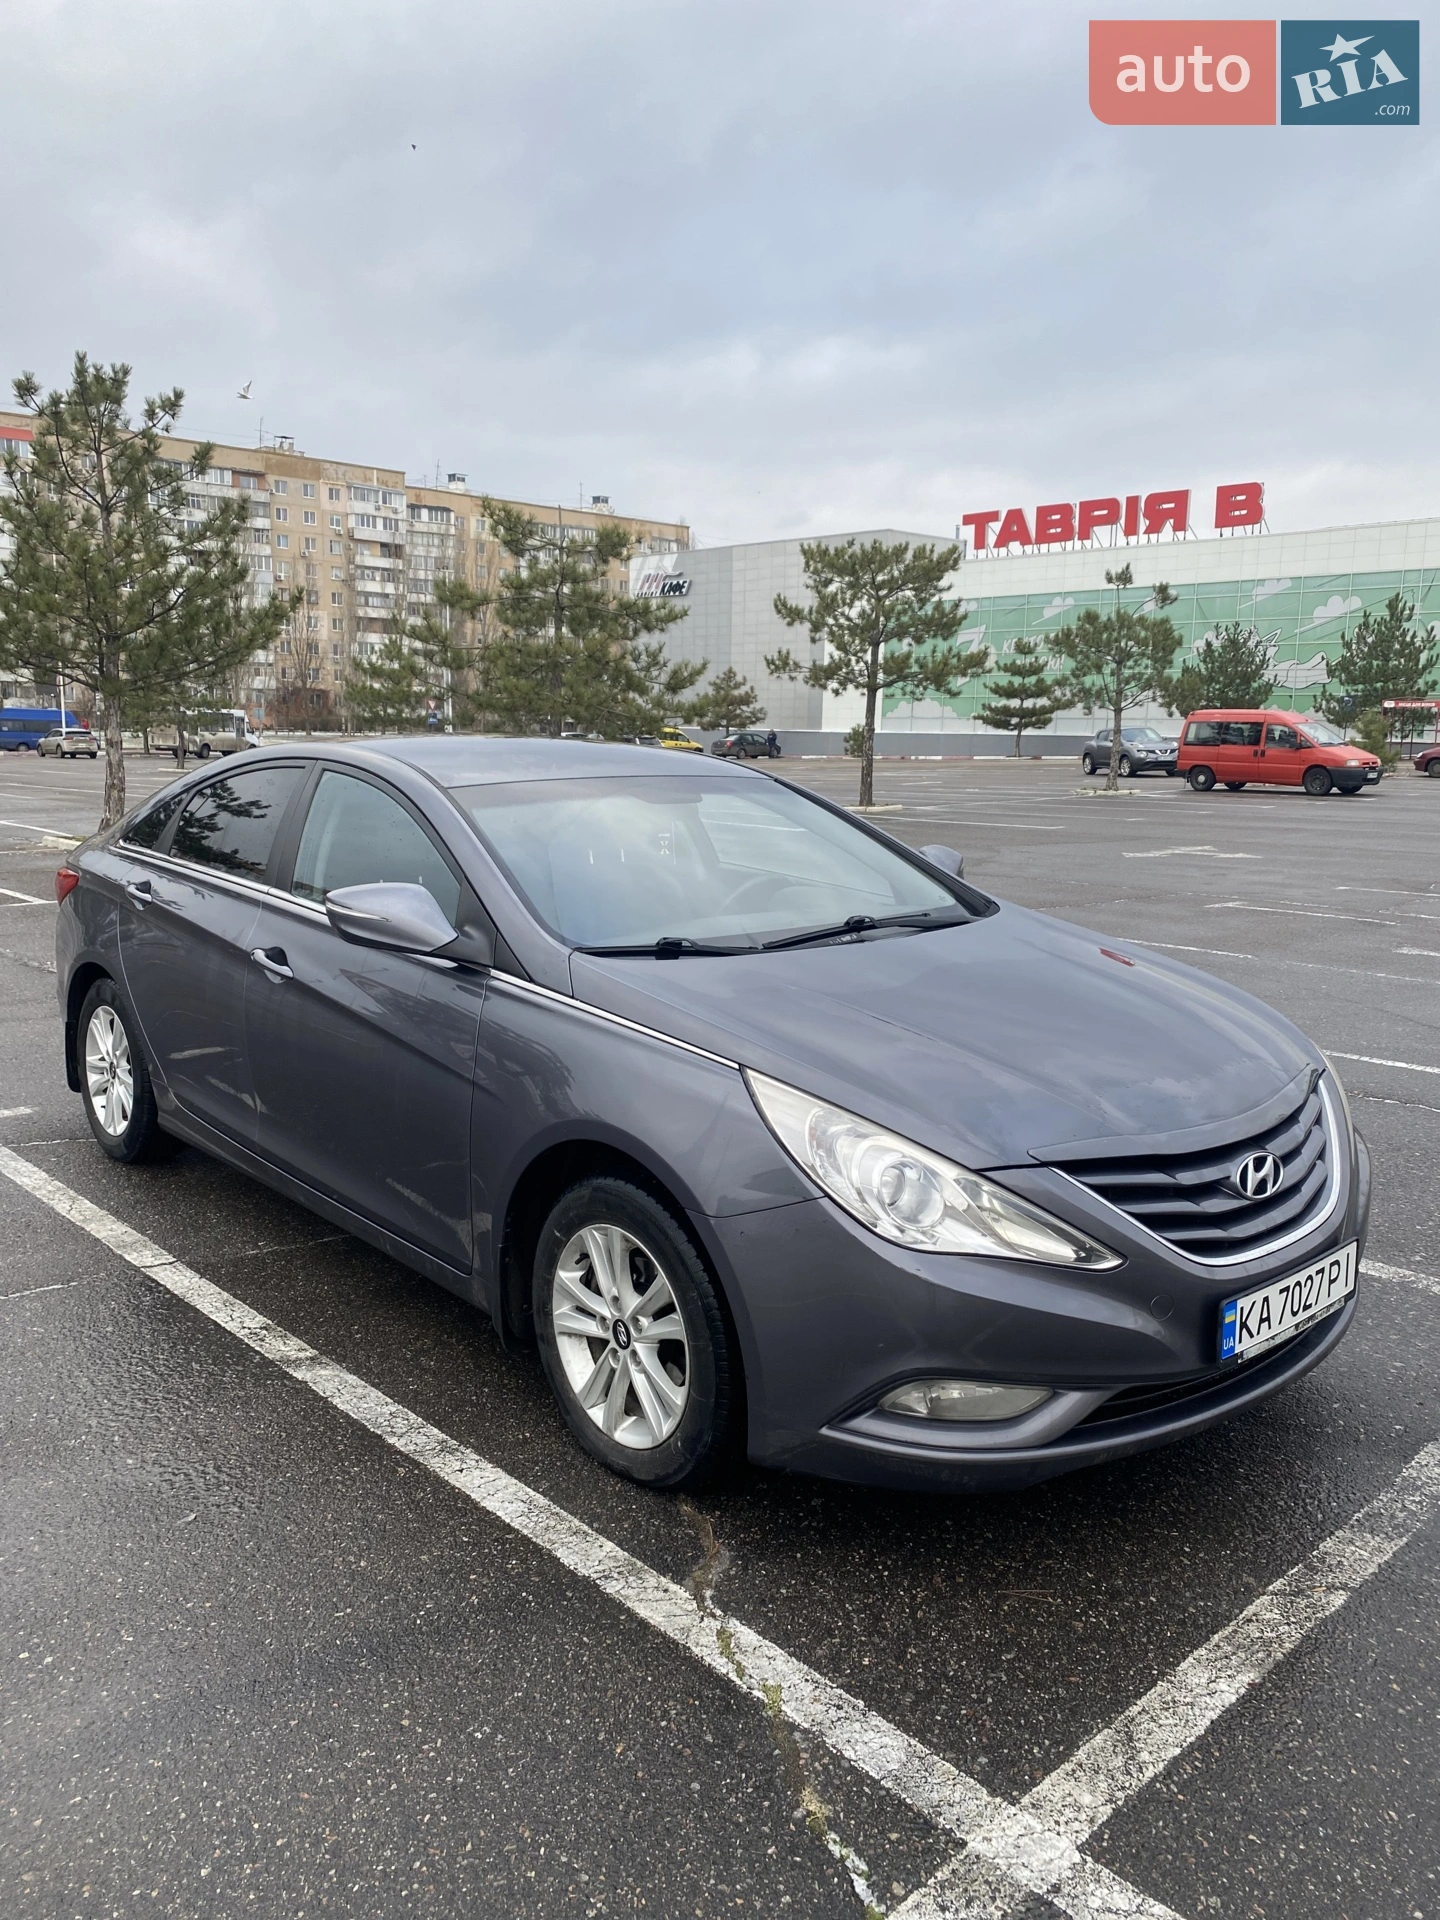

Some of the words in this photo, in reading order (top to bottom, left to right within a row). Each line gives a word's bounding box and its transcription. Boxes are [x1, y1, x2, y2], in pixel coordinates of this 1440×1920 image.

[962, 489, 1191, 550] ТАВРІЯ
[1214, 482, 1264, 529] В
[660, 580, 688, 595] КАФЕ
[1238, 1295, 1272, 1344] KA
[1278, 1266, 1325, 1325] 7027
[1223, 1337, 1235, 1350] UA
